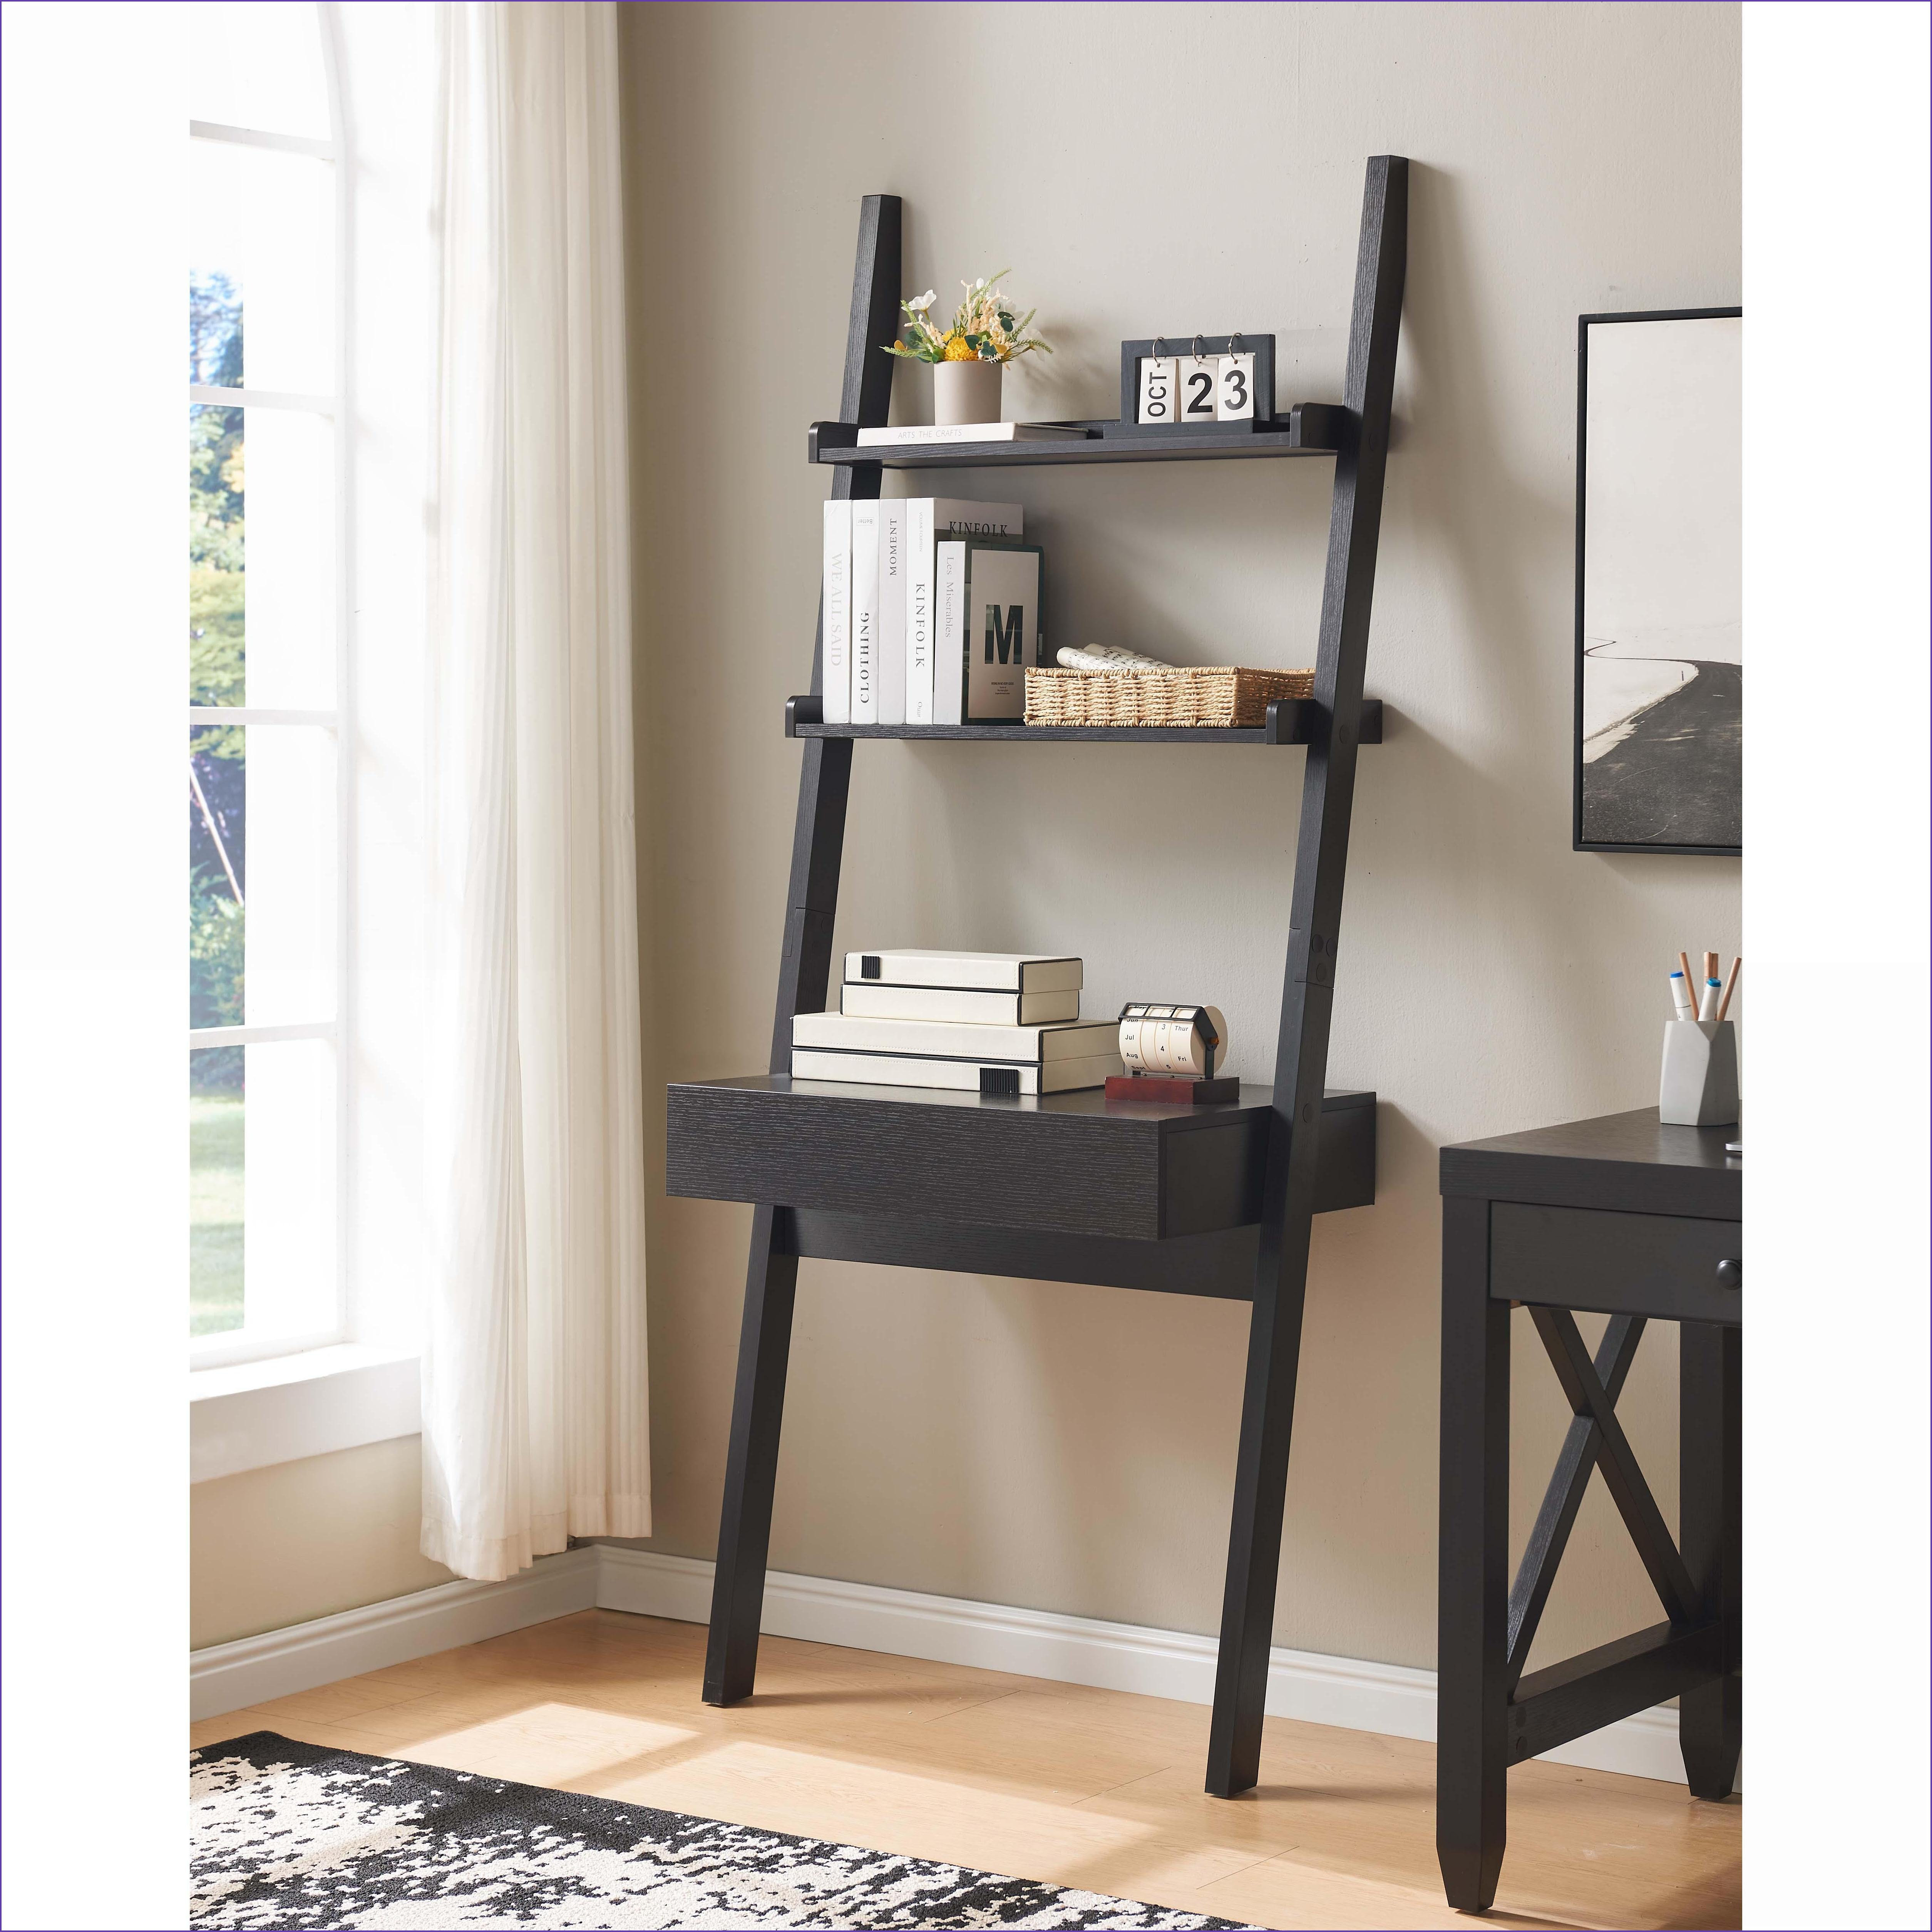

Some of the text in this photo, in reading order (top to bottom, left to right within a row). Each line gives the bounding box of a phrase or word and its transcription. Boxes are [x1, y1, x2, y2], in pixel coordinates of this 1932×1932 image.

[1147, 372, 1167, 417] OCT
[936, 429, 962, 437] CRAFTS
[949, 521, 1008, 537] KINFOLK
[831, 553, 842, 666] WE ALL SAID
[916, 583, 925, 668] KINFOLK
[945, 582, 954, 638] Miserables
[984, 604, 1023, 665] M
[860, 612, 870, 703] CLOTHING
